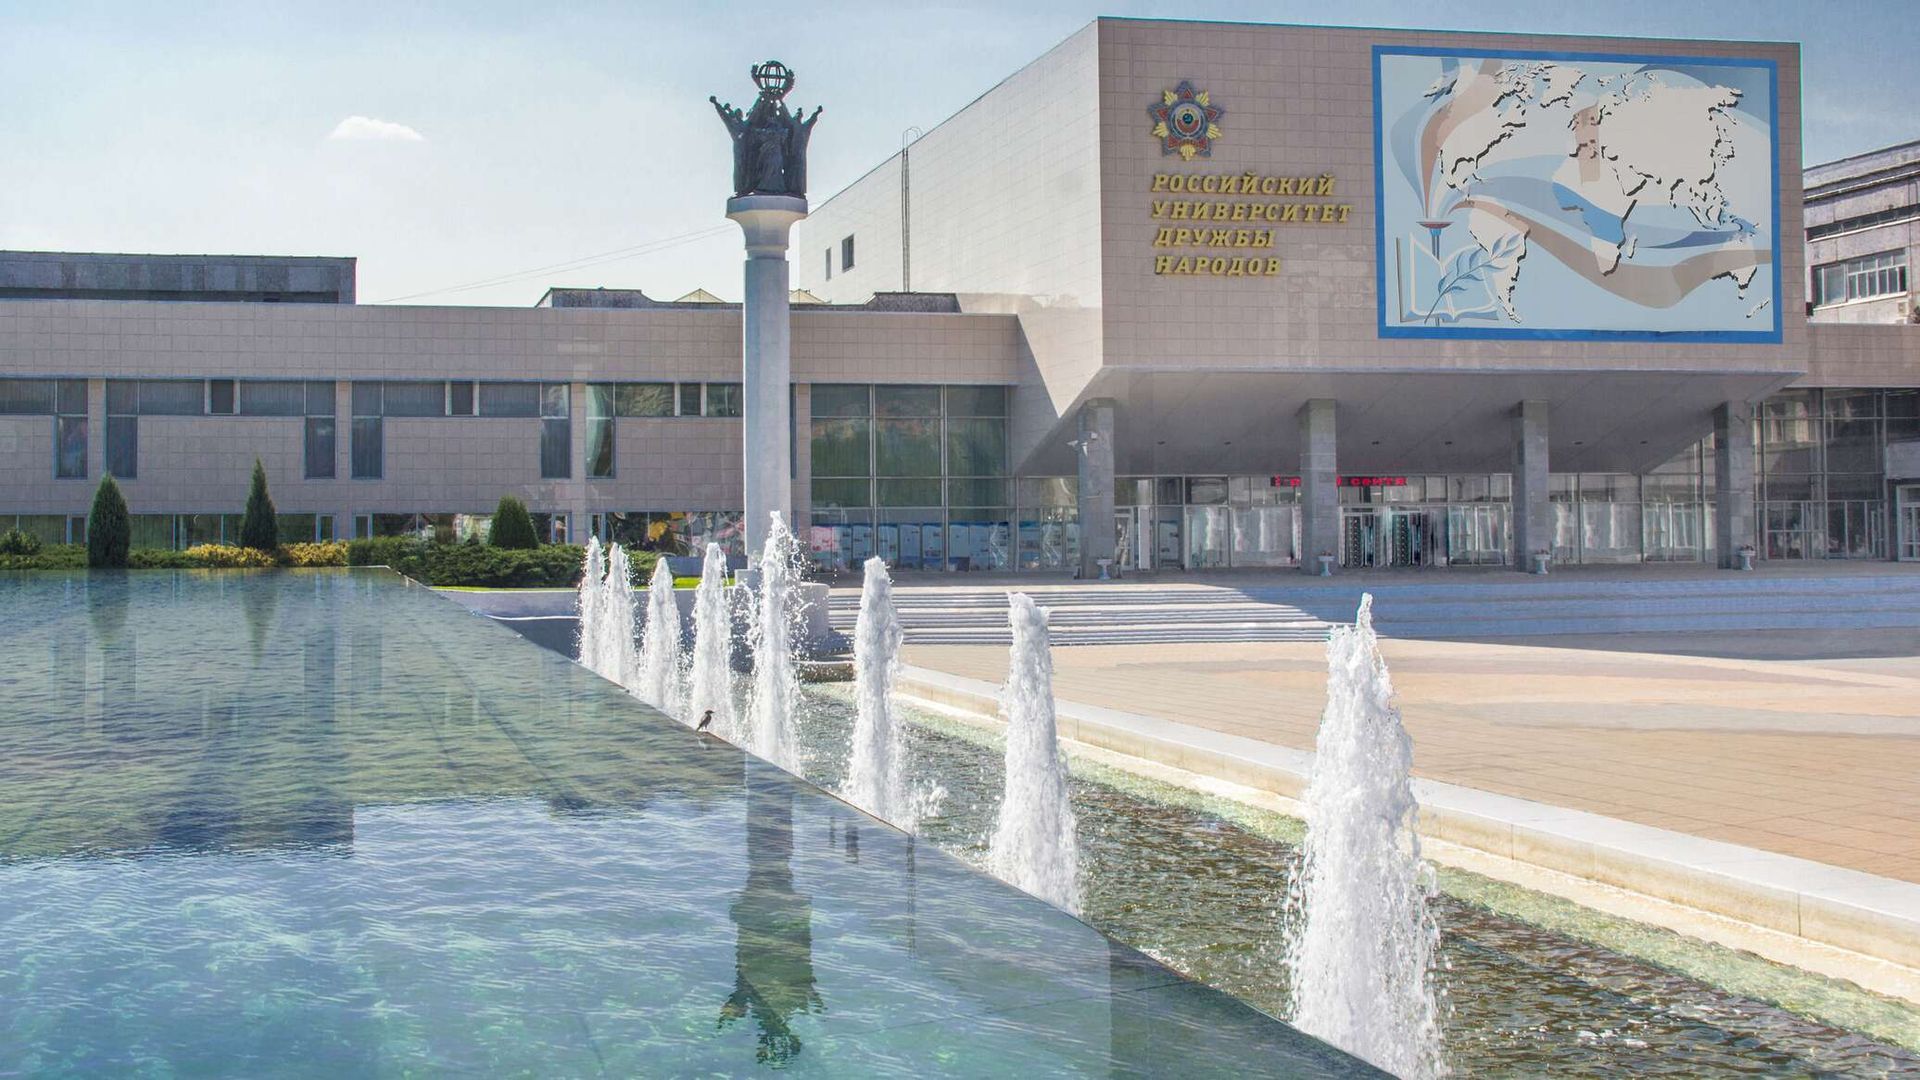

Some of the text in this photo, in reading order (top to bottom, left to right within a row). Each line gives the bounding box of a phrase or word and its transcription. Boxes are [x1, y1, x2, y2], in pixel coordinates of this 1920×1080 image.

[1151, 172, 1336, 196] РОССИЙСКИЙ
[1151, 200, 1354, 223] УНИВЕРСИТЕТ
[1154, 227, 1277, 248] ДРУЖБЫ
[1155, 255, 1282, 276] НАРОДОВ
